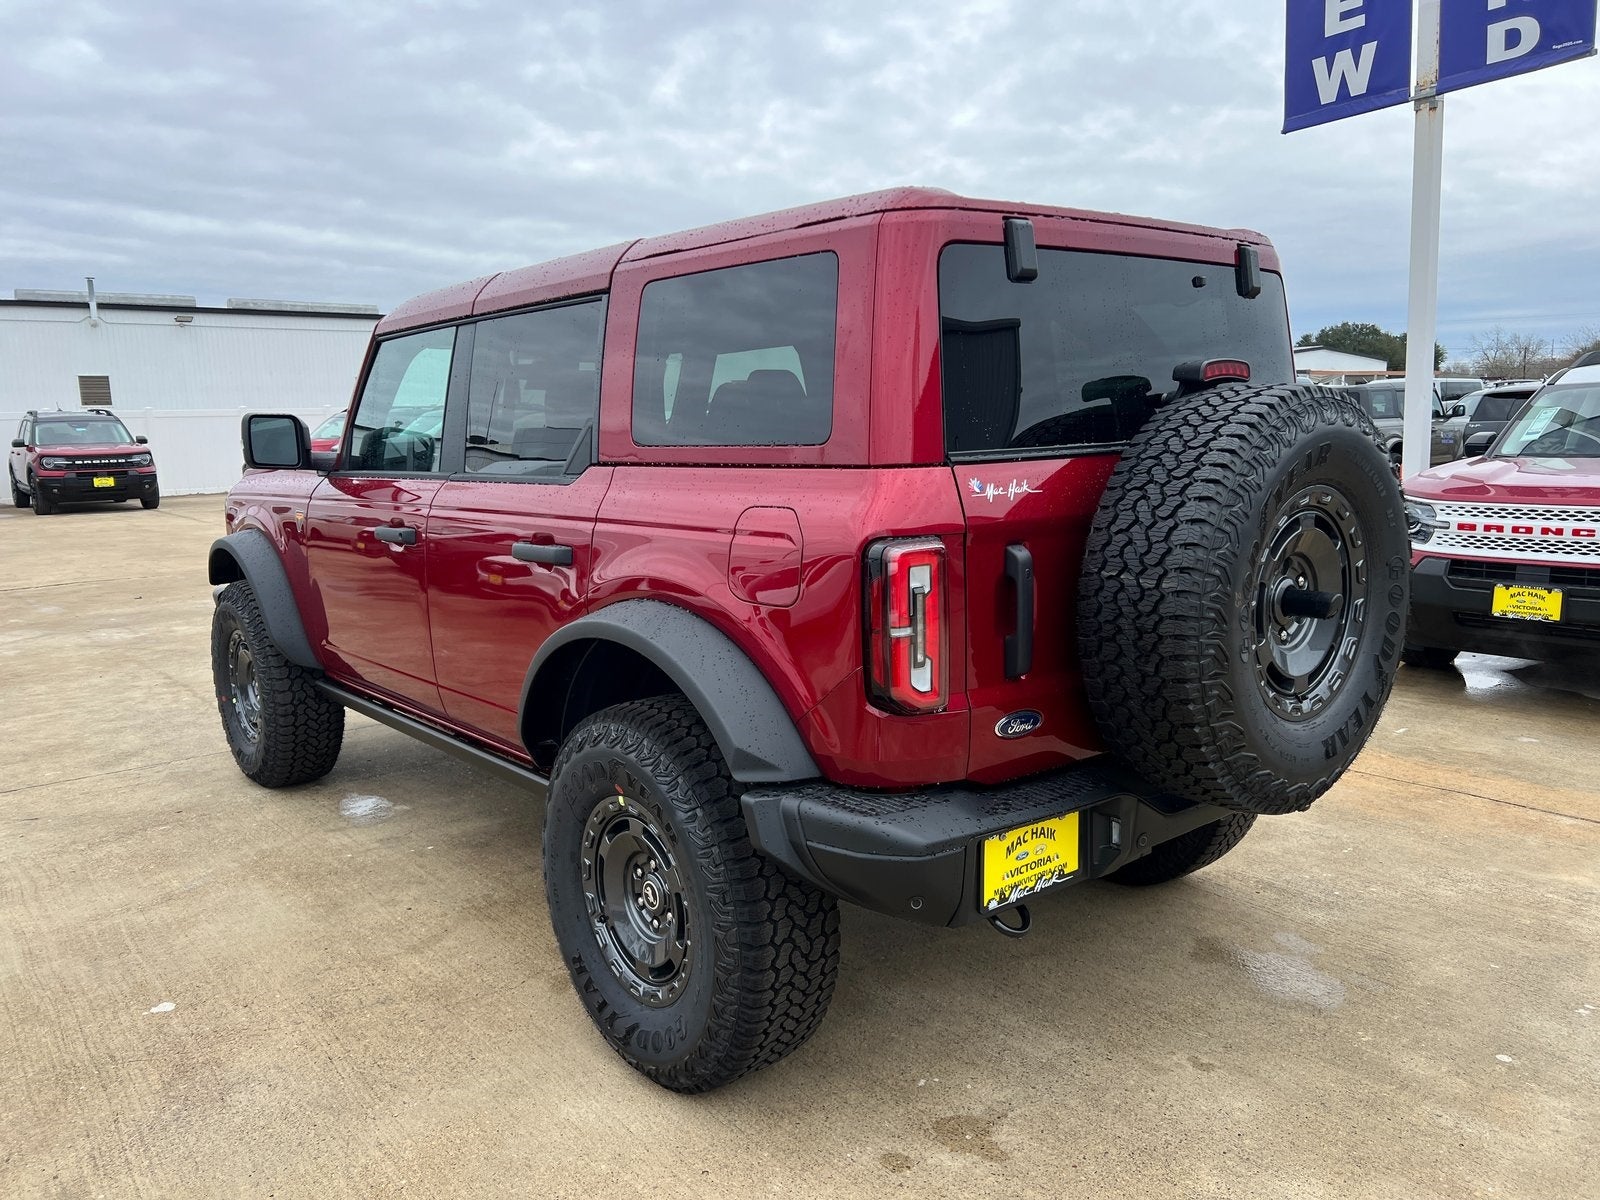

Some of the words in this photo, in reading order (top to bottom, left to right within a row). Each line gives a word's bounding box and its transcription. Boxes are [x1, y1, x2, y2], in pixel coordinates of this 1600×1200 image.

[981, 483, 1007, 502] Mac
[1008, 478, 1043, 501] Haik
[1457, 522, 1596, 537] BRONC
[1509, 591, 1526, 599] MAC
[1527, 591, 1546, 601] HAIK
[1512, 604, 1542, 612] VICTORIA
[1007, 718, 1034, 734] Ford
[1005, 831, 1029, 859] MAC
[1030, 826, 1056, 842] HAIK
[1009, 855, 1052, 878] VICTORIA
[1006, 885, 1033, 903] Mac
[1034, 871, 1072, 893] Haik
